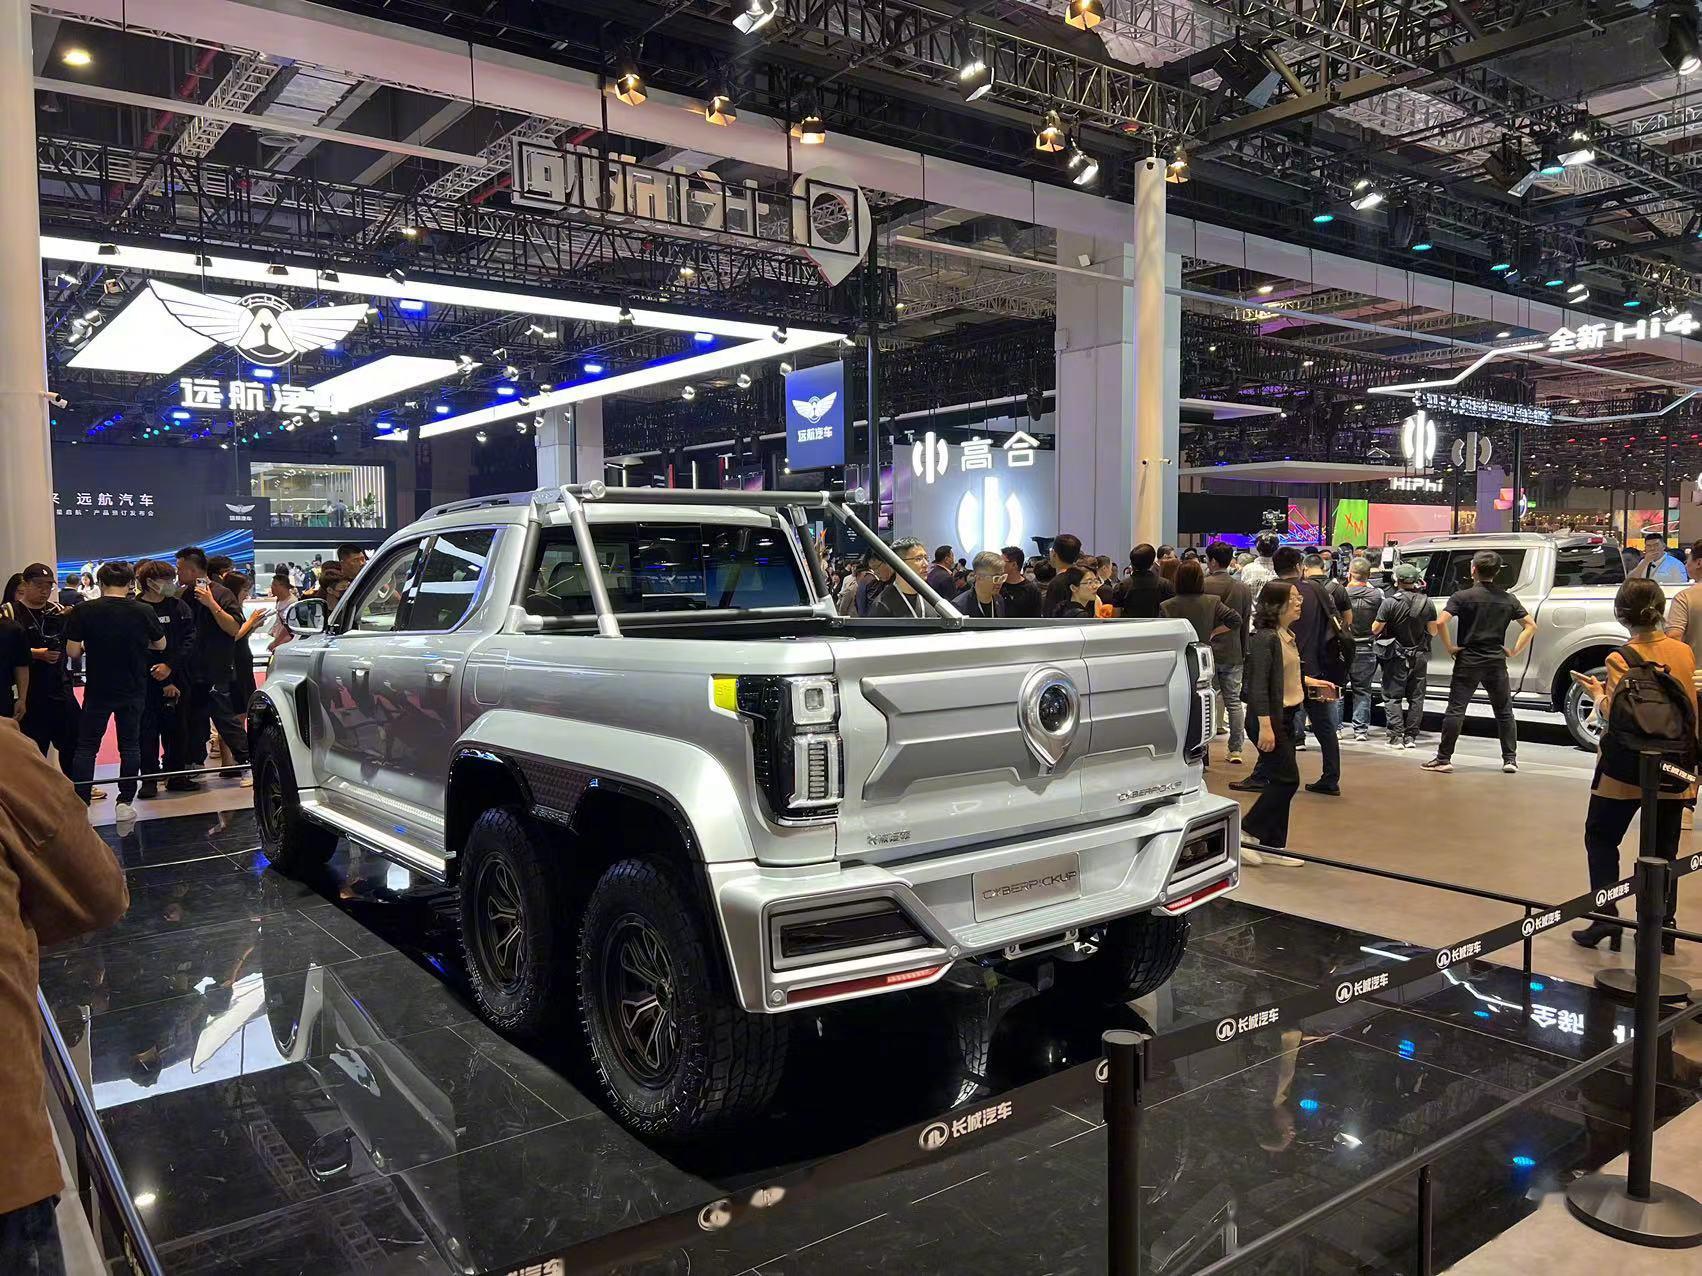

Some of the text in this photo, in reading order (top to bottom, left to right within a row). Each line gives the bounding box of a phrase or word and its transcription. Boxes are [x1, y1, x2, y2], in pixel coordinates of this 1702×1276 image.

[1548, 313, 1701, 352] 全新 Hi4
[798, 427, 833, 443] 远航汽车
[961, 430, 1041, 472] 高合
[1391, 477, 1444, 492] HiPhi
[76, 492, 154, 507] 远航汽车
[982, 871, 1077, 900] CYBERPICKUP
[1451, 940, 1482, 962] 长城汽车
[1353, 972, 1389, 996] 长城汽车
[1237, 1007, 1279, 1033] 长城汽车
[951, 1100, 1012, 1138] 长城汽车
